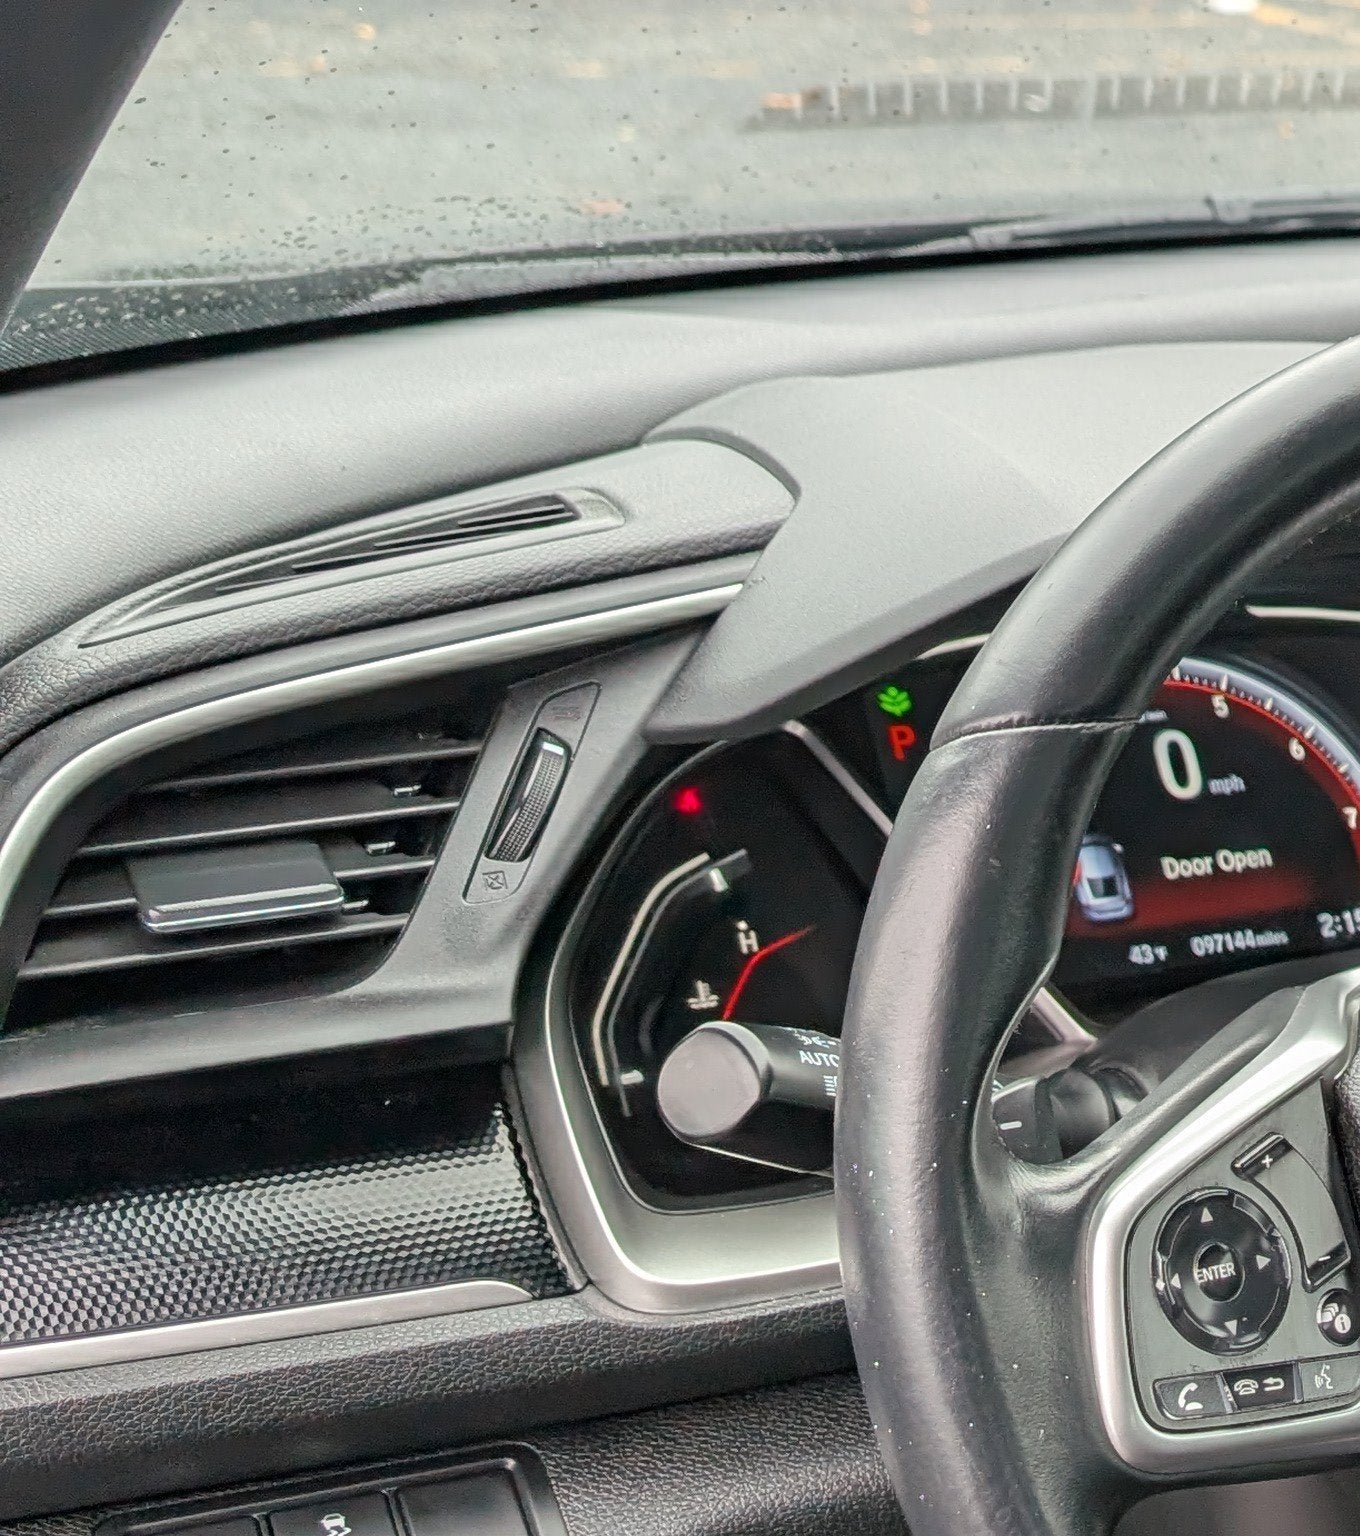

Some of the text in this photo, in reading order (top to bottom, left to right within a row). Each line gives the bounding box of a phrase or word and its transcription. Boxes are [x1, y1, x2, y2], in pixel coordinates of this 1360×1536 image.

[1212, 694, 1230, 718] 5
[889, 724, 917, 762] P
[1288, 737, 1306, 762] 6
[1152, 728, 1204, 800] 0
[1207, 773, 1246, 796] mph
[1341, 806, 1358, 831] 7
[1160, 848, 1273, 881] Door Open
[1195, 1262, 1237, 1283] ENTER
